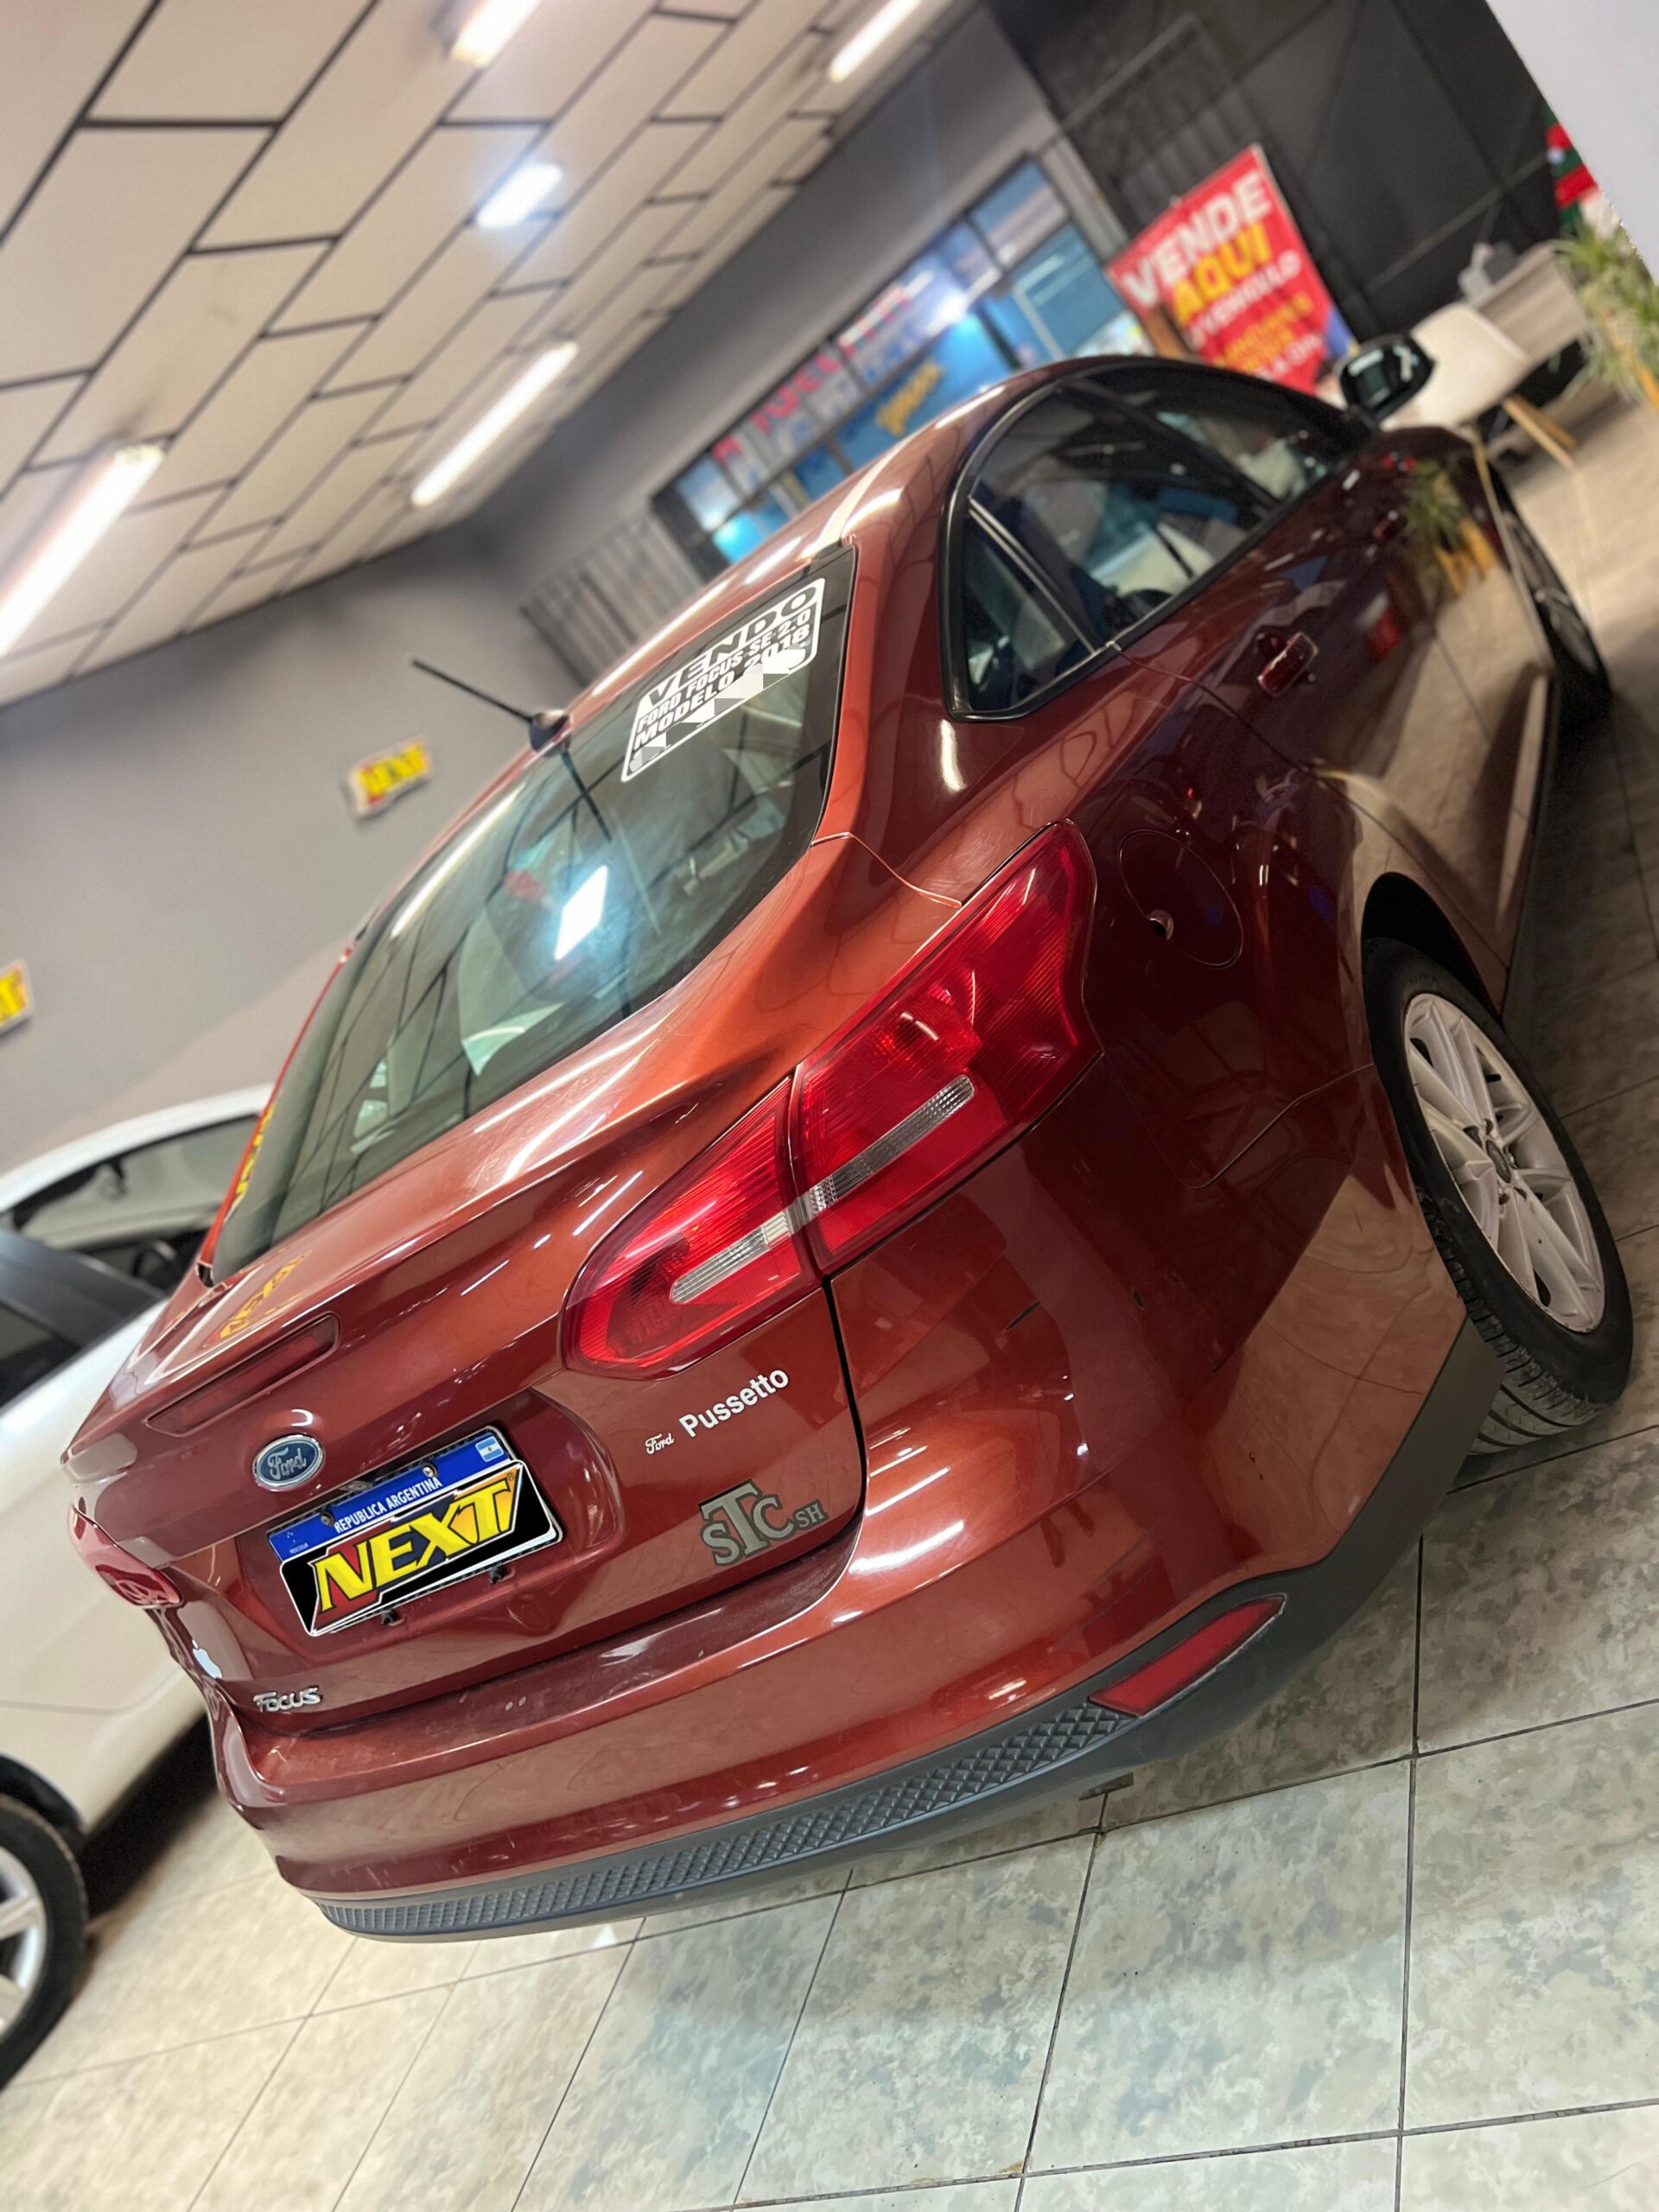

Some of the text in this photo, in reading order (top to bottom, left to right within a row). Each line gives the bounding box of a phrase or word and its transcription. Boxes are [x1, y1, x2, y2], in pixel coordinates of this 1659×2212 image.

[1123, 169, 1273, 311] VENDE
[1172, 221, 1272, 328] AQUI
[634, 672, 734, 751] MODELO
[744, 624, 810, 671] 2018
[638, 608, 810, 734] FORD FOCUS SE 2.0
[648, 587, 817, 707] VENDO
[267, 1446, 307, 1480] Ford
[645, 1370, 789, 1455] Ford Pussetto
[314, 1478, 512, 1613] NEXT
[334, 1477, 443, 1534] REPUBLICA ARGENTINA
